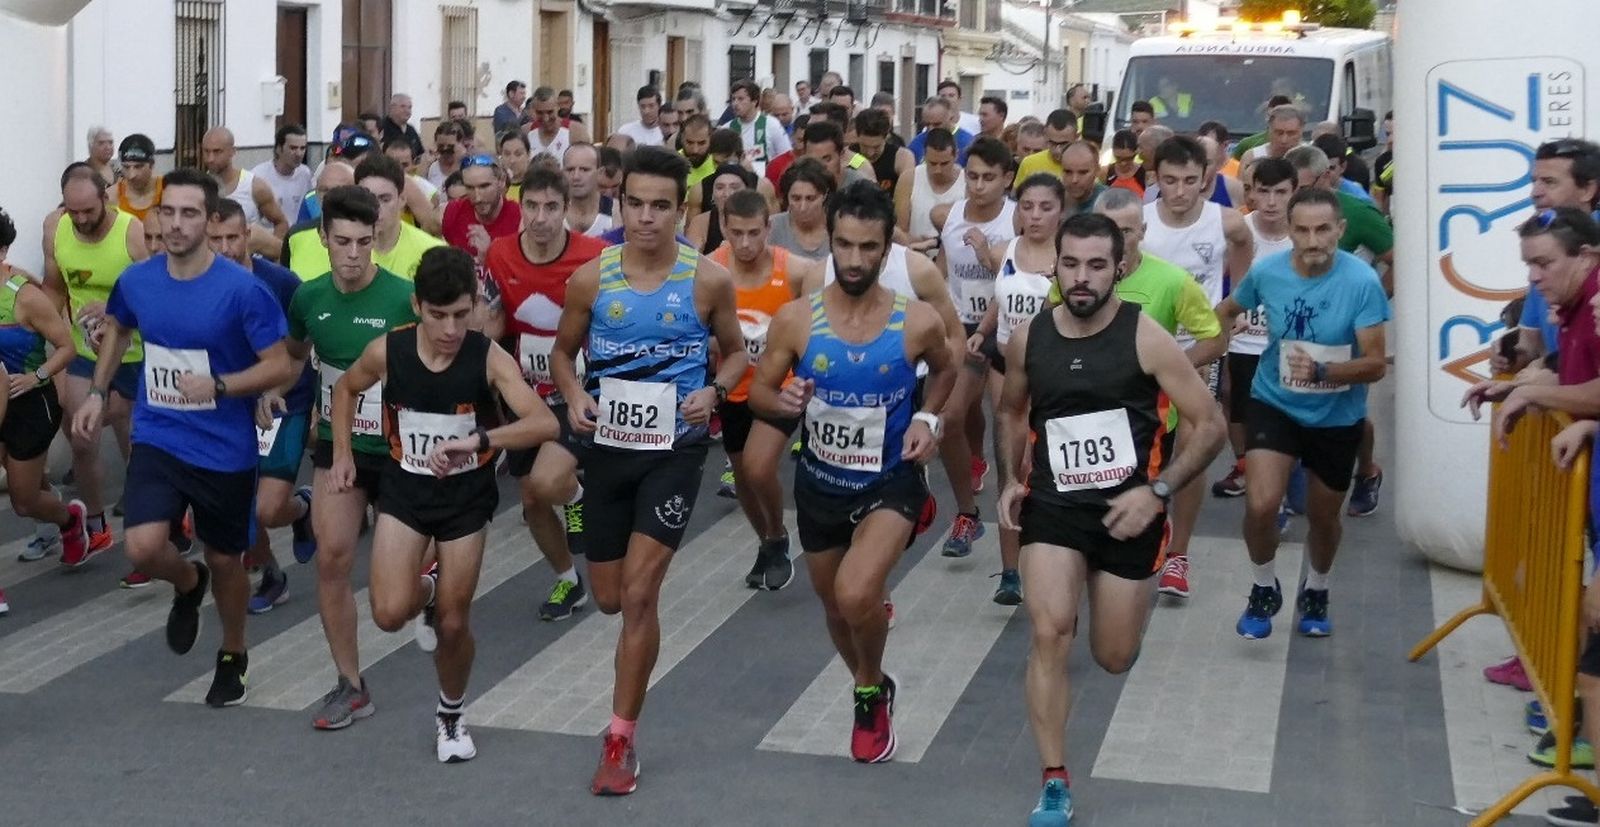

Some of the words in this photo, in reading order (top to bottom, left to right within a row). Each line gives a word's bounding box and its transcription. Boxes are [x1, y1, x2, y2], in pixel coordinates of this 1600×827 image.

[969, 296, 994, 312] 18
[1006, 293, 1046, 315] 1837
[592, 333, 704, 358] HISPASUR
[816, 387, 906, 406] SPASUR
[608, 399, 659, 429] 1852
[600, 425, 671, 446] Cruzcampo
[811, 421, 866, 450] 1854
[811, 437, 879, 466] Cruzcampo
[1059, 436, 1116, 470] 1793
[1058, 465, 1135, 486] Cruzcampo
